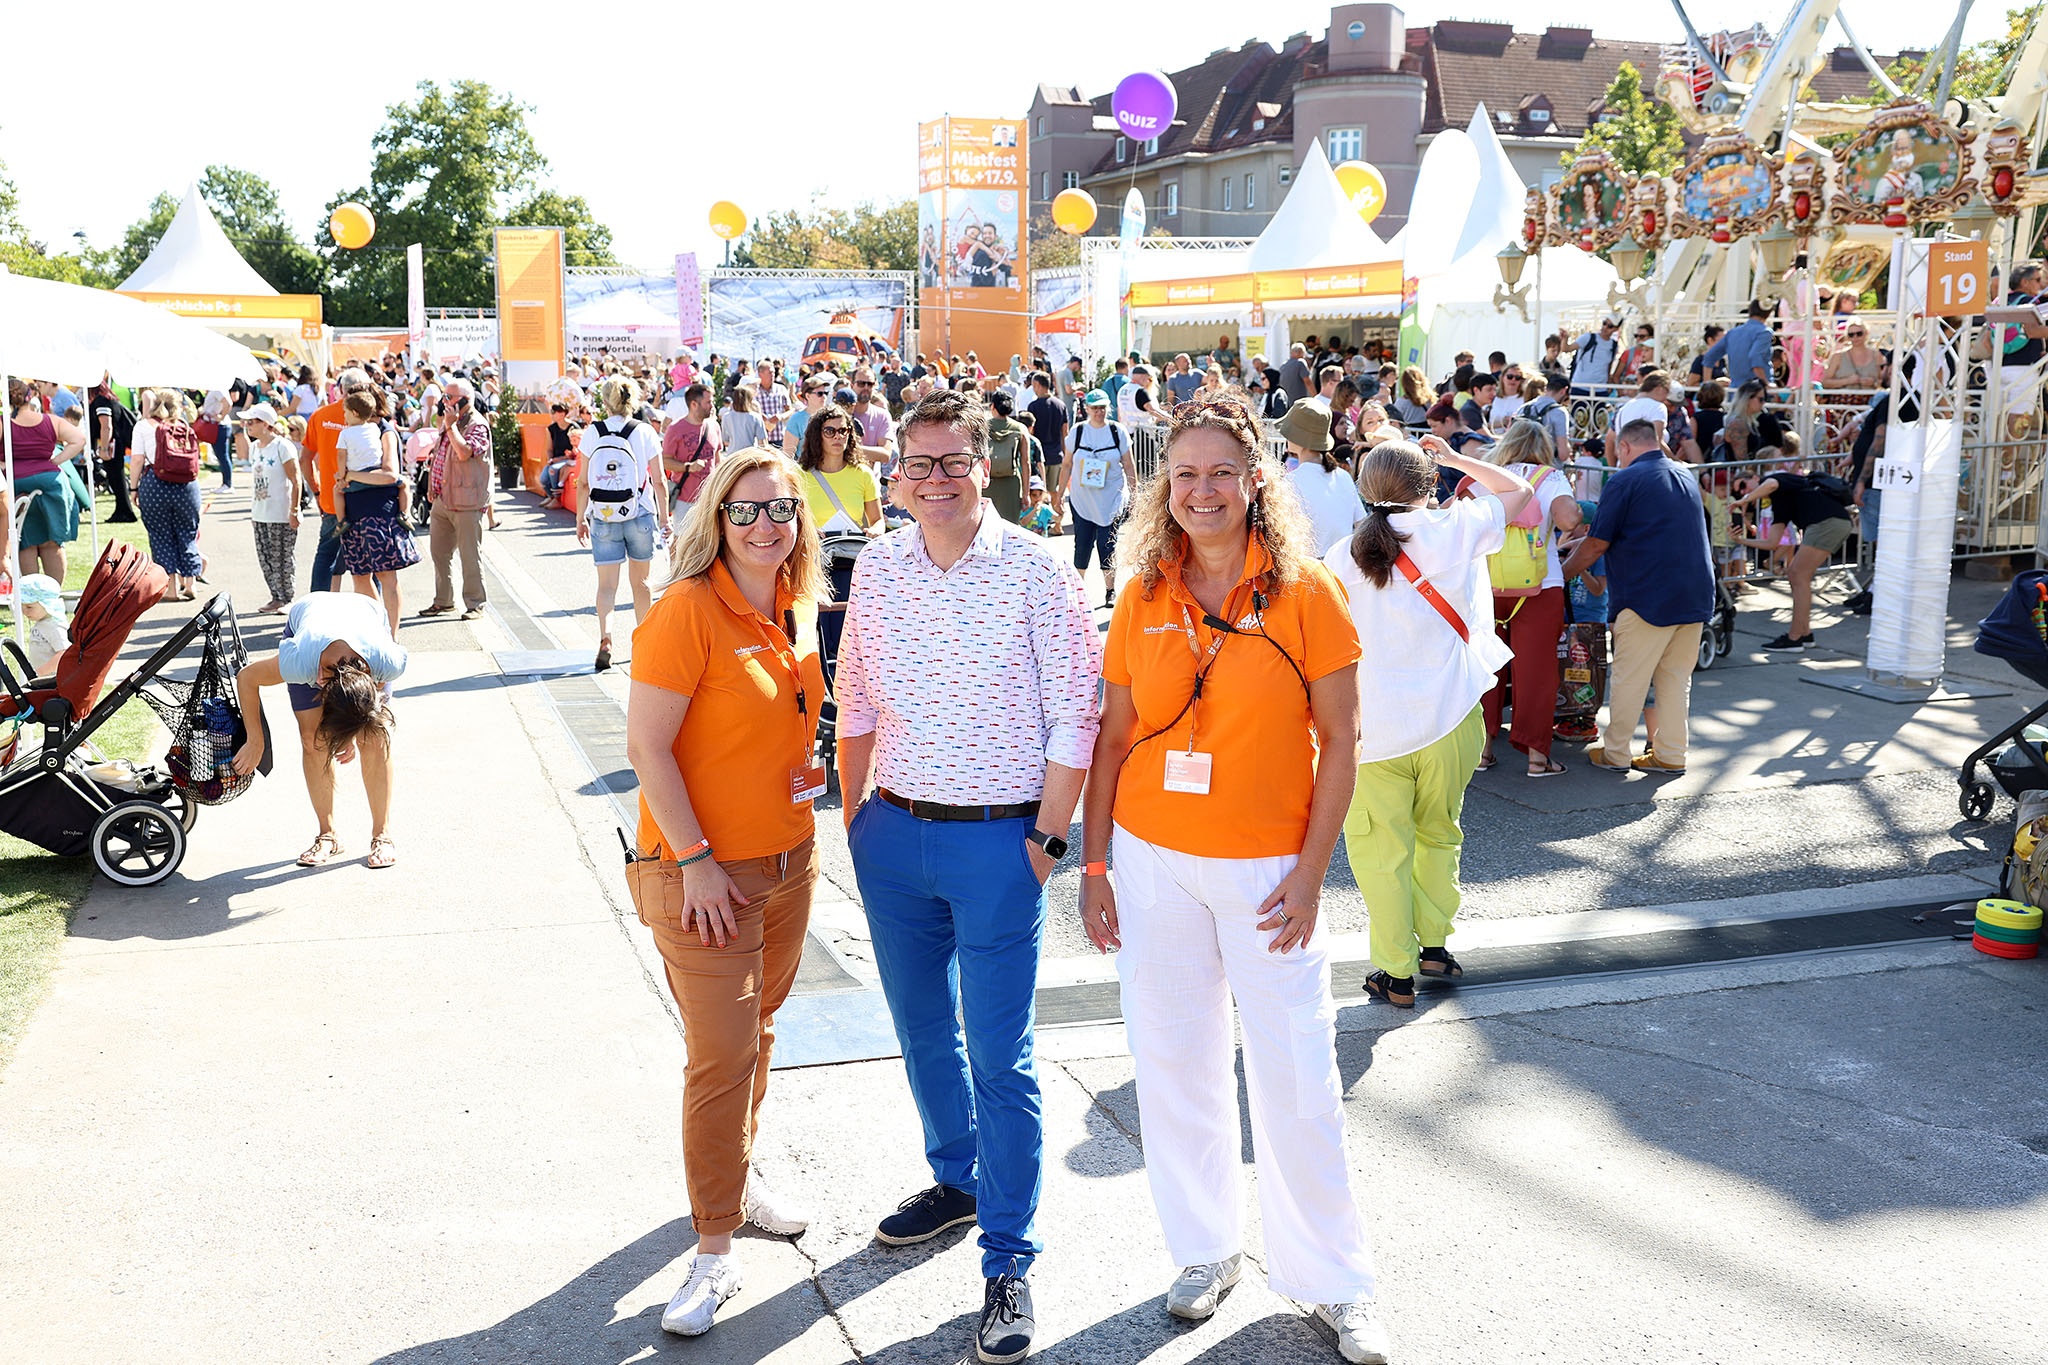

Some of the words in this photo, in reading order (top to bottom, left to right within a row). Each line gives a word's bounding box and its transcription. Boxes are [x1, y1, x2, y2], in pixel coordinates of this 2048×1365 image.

[1118, 109, 1158, 129] QUIZ
[951, 150, 1018, 168] Mistfest
[951, 168, 1019, 185] 16.+17.9.
[1944, 249, 1974, 262] Stand
[1939, 272, 1977, 305] 19
[215, 300, 242, 312] Post
[304, 327, 319, 338] 23
[435, 324, 463, 332] Meine
[465, 324, 492, 333] Stadt,
[435, 334, 464, 342] meine
